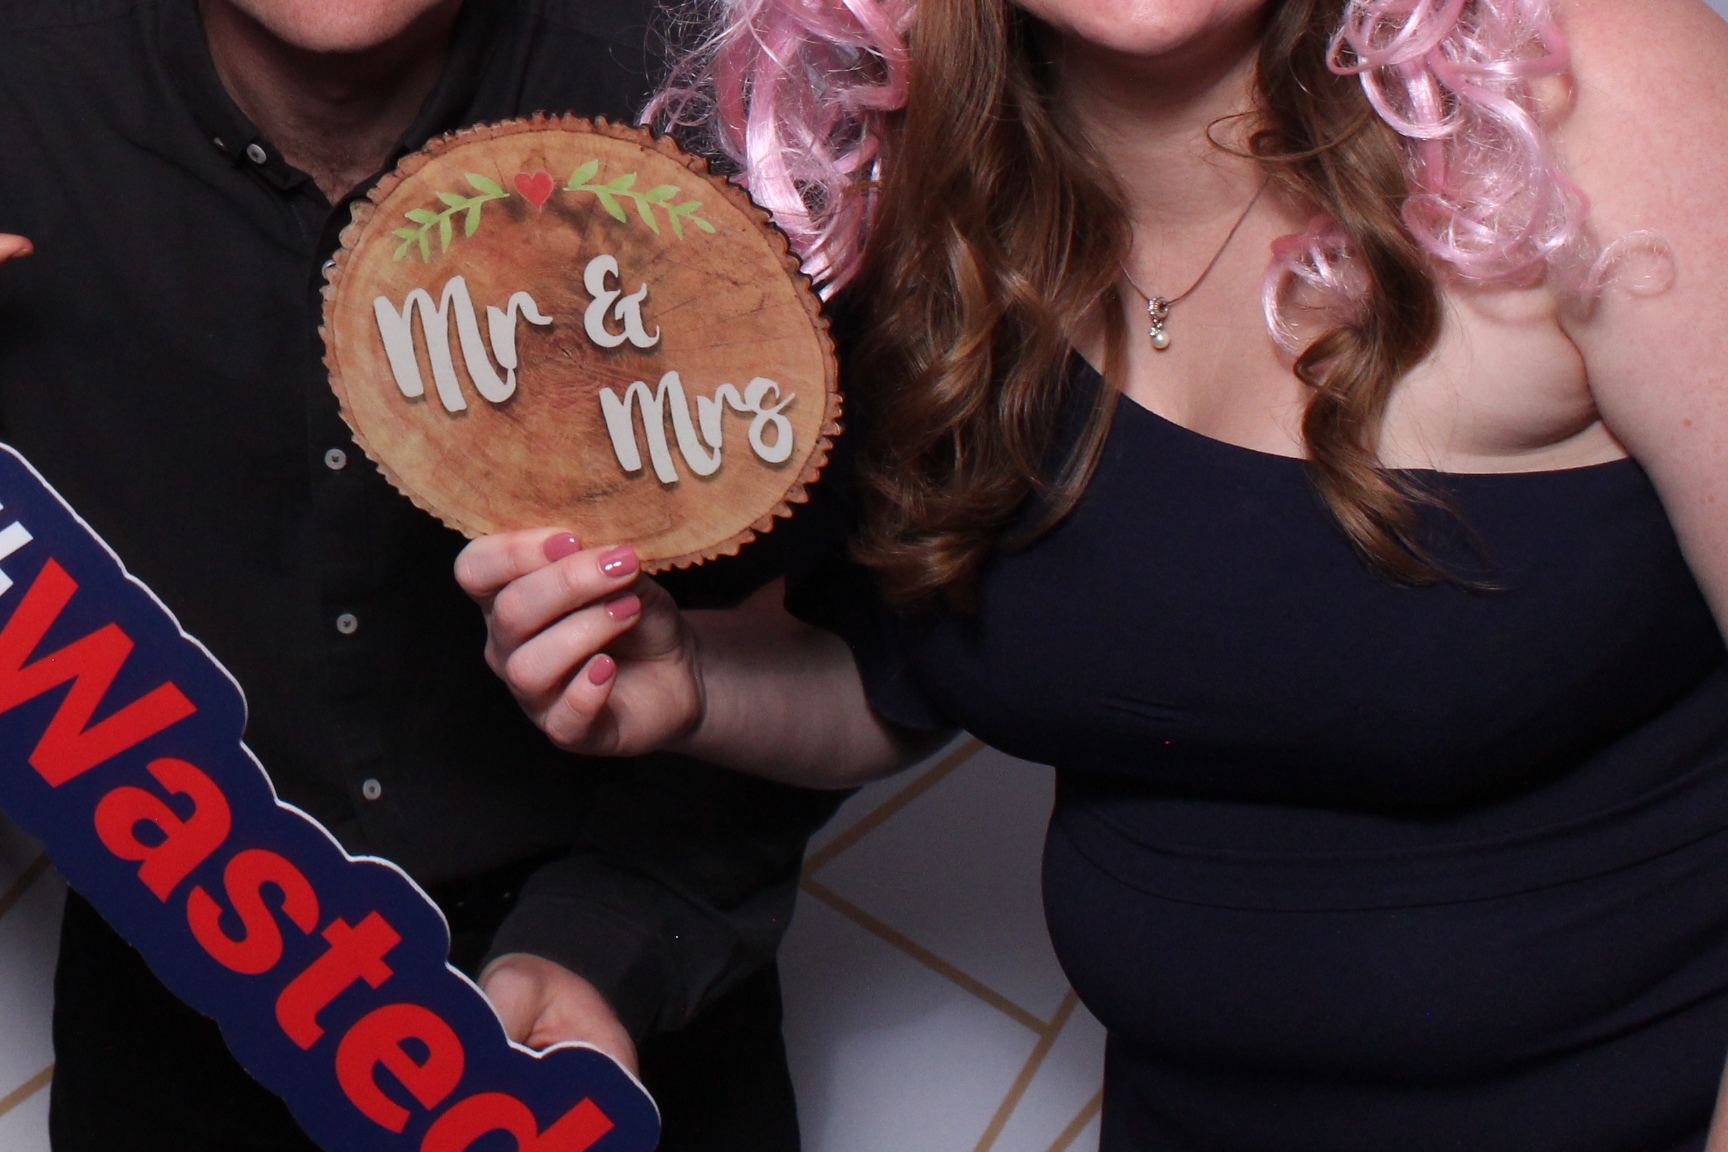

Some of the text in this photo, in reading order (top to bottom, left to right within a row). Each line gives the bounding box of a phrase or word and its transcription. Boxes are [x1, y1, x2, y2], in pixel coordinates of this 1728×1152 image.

[373, 254, 660, 413] Mr &
[598, 370, 796, 484] Mrs
